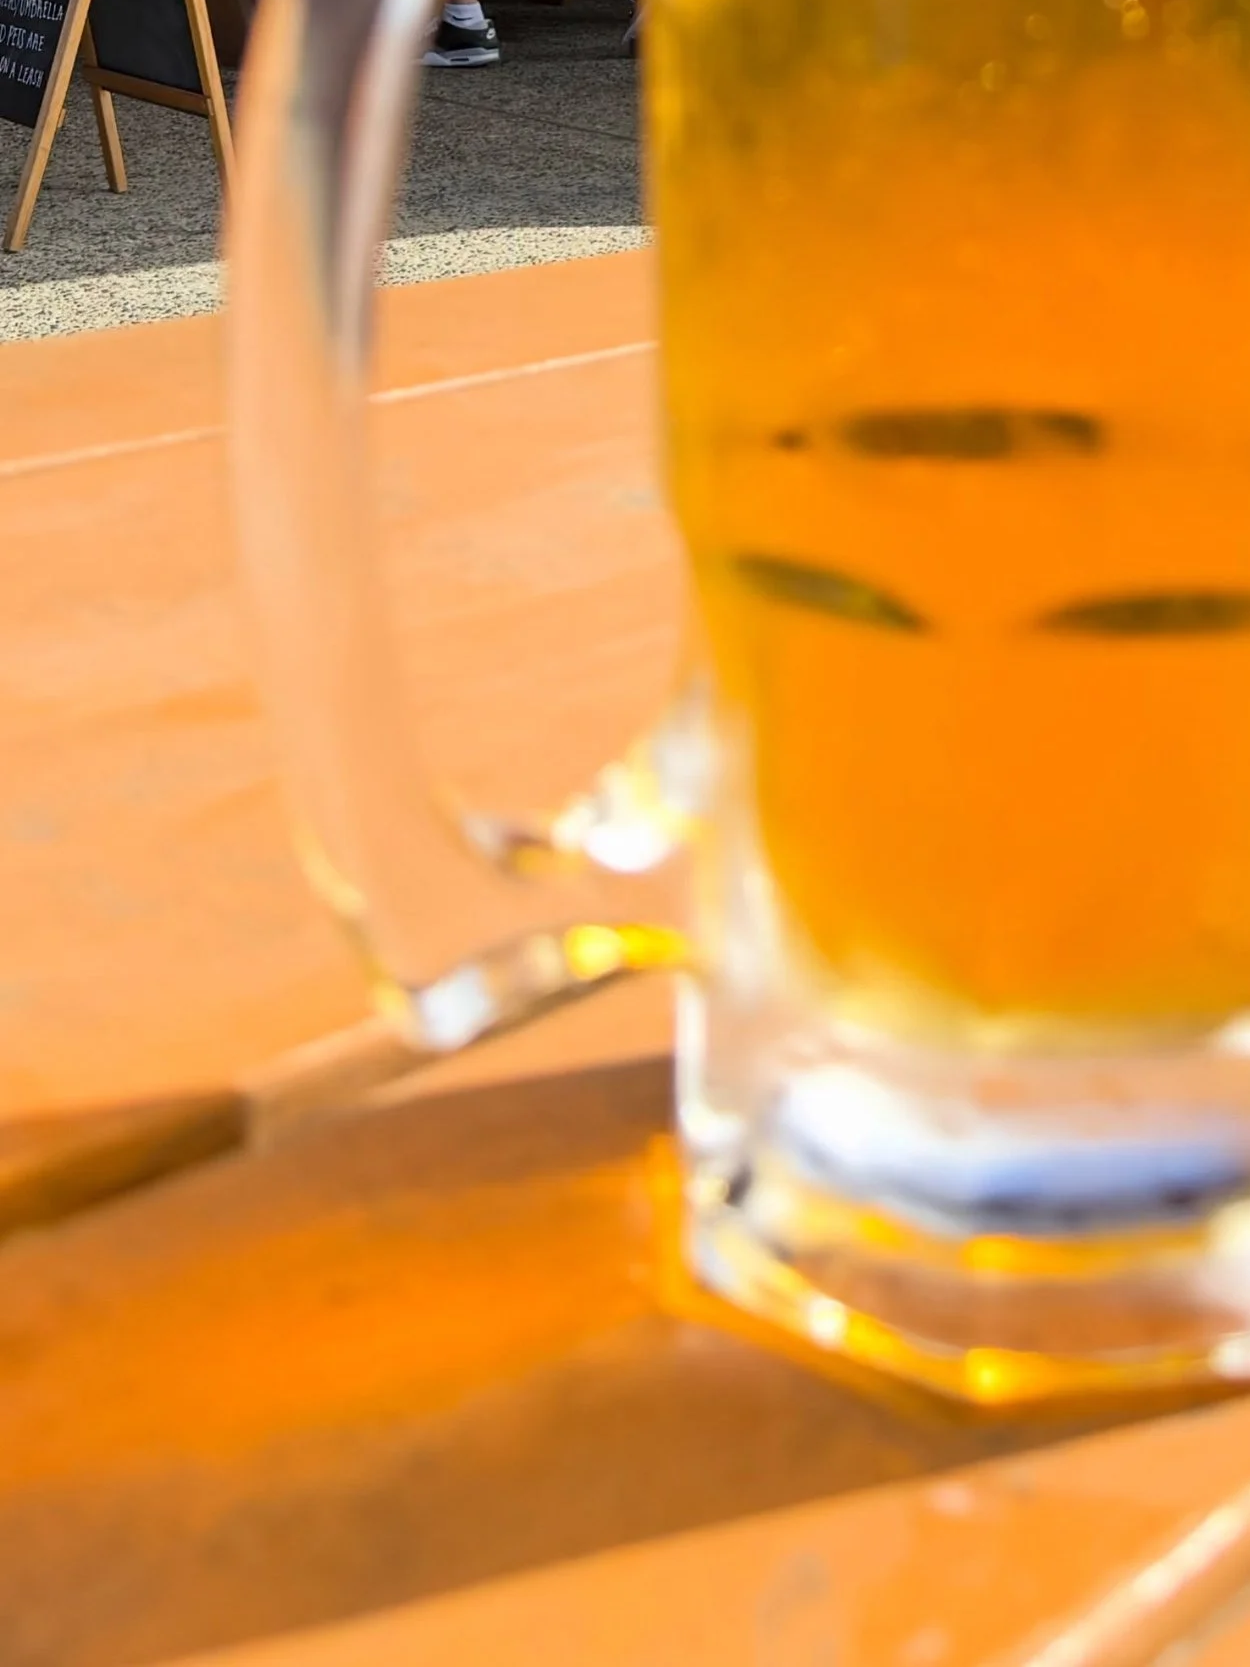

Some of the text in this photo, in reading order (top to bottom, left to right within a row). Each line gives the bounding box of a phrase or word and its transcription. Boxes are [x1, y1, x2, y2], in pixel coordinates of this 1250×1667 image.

[7, 24, 27, 50] PETS
[26, 31, 45, 52] ARE
[9, 61, 16, 79] A
[17, 64, 45, 89] LEASH
